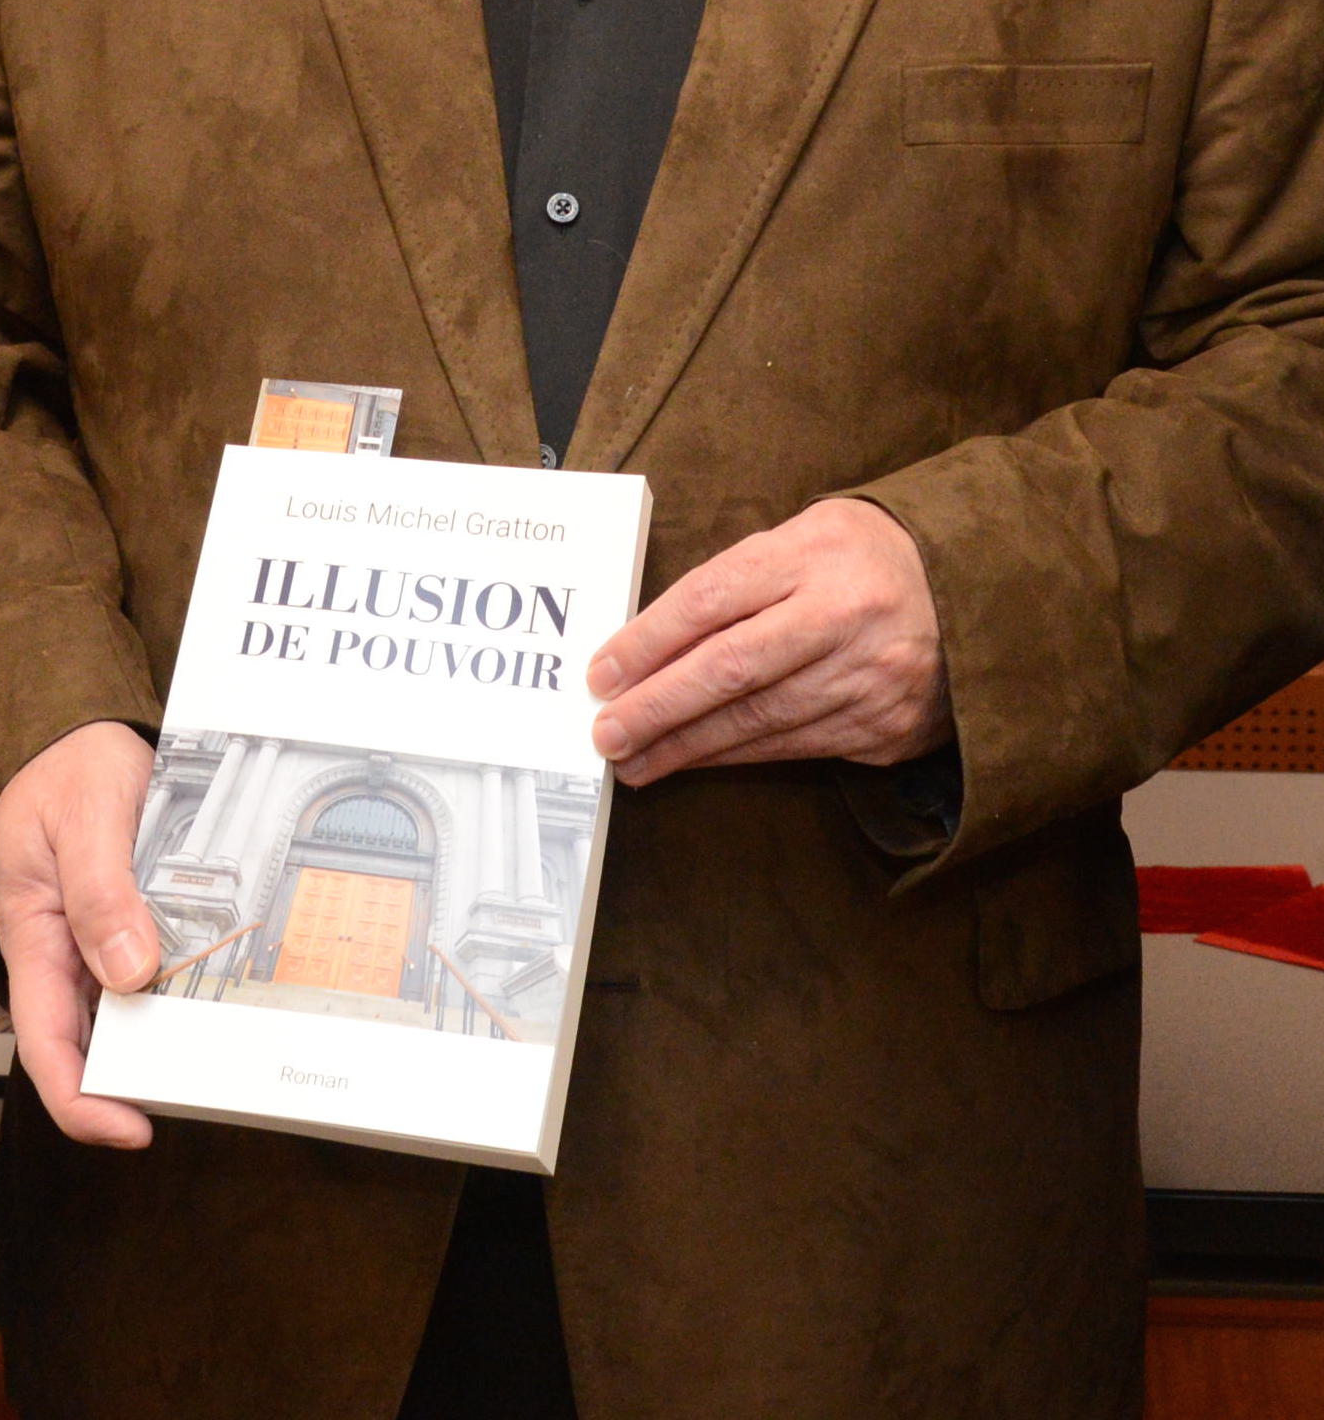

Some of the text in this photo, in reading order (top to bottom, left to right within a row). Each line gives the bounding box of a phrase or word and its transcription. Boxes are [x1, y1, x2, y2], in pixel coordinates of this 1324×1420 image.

[287, 496, 564, 542] Louis Michel Gratton
[248, 557, 577, 637] ILLUSION
[236, 621, 562, 691] DE POUVOIR
[281, 1066, 347, 1088] Roman
